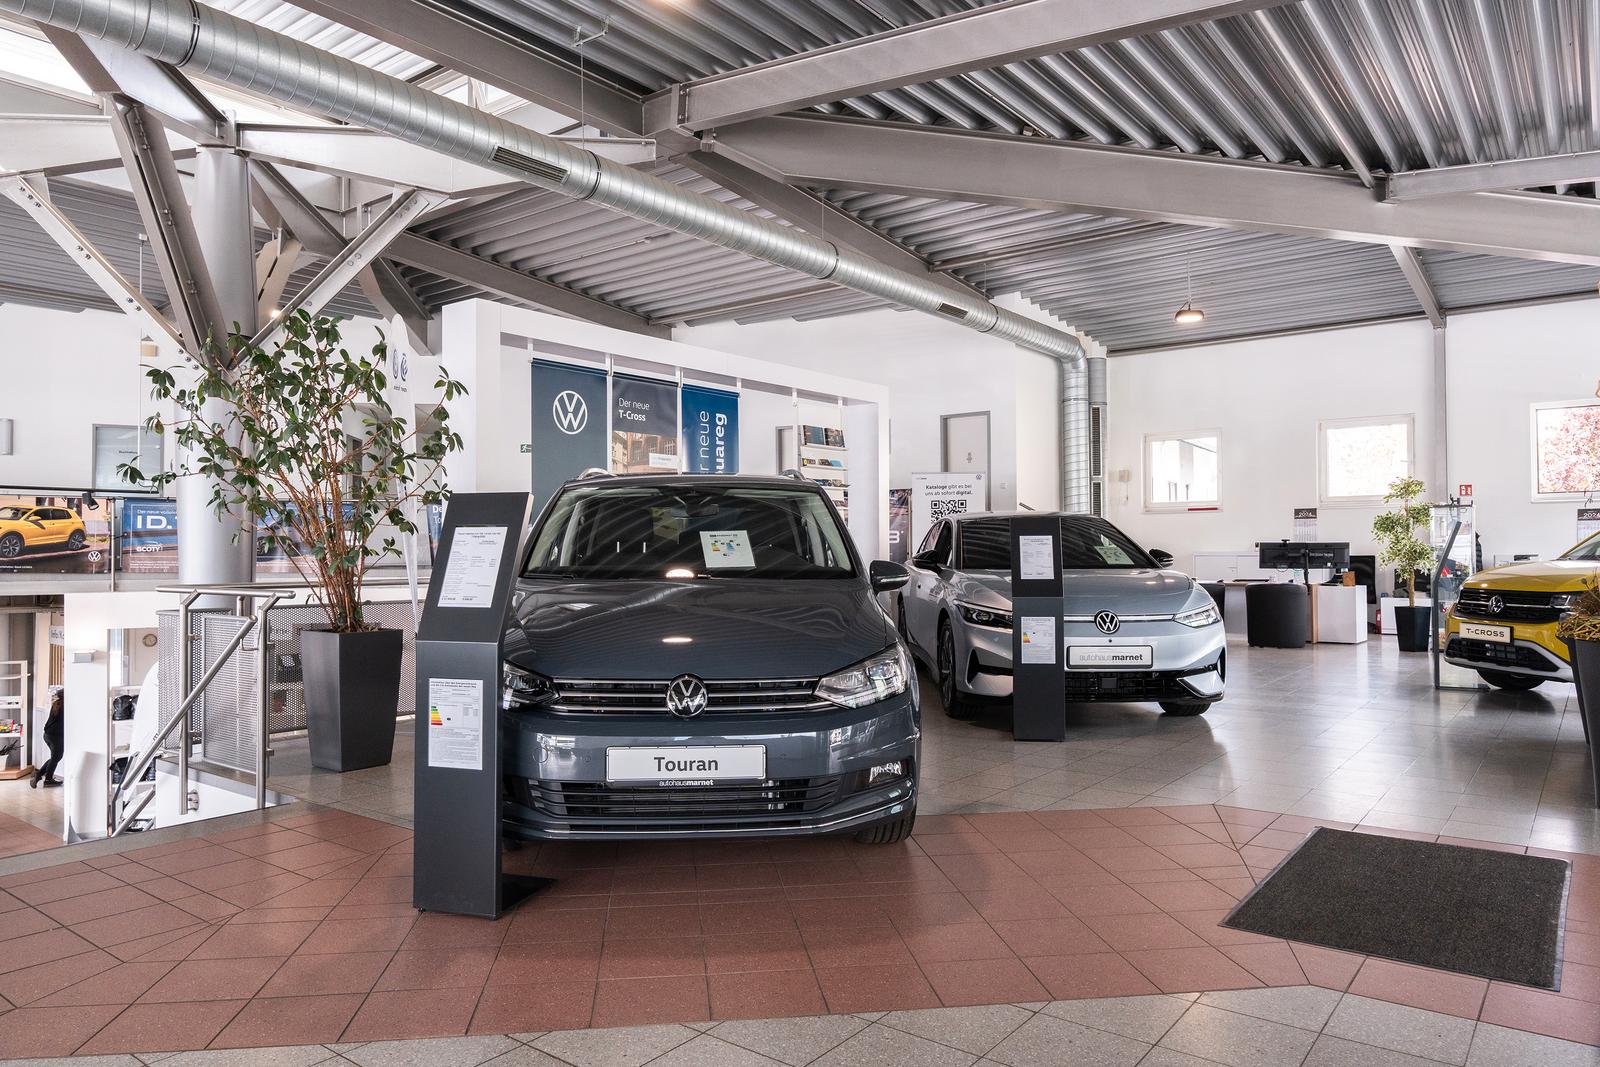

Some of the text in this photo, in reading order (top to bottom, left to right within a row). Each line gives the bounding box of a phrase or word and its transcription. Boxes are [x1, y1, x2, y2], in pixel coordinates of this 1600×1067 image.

[618, 397, 650, 411] Der neue
[618, 409, 646, 421] T-Cross
[699, 410, 710, 458] neue
[715, 413, 728, 474] uareg
[136, 514, 177, 529] ID.
[1466, 627, 1505, 637] T-CROSS
[653, 756, 719, 772] Touran
[659, 779, 714, 787] autohausmarnet
